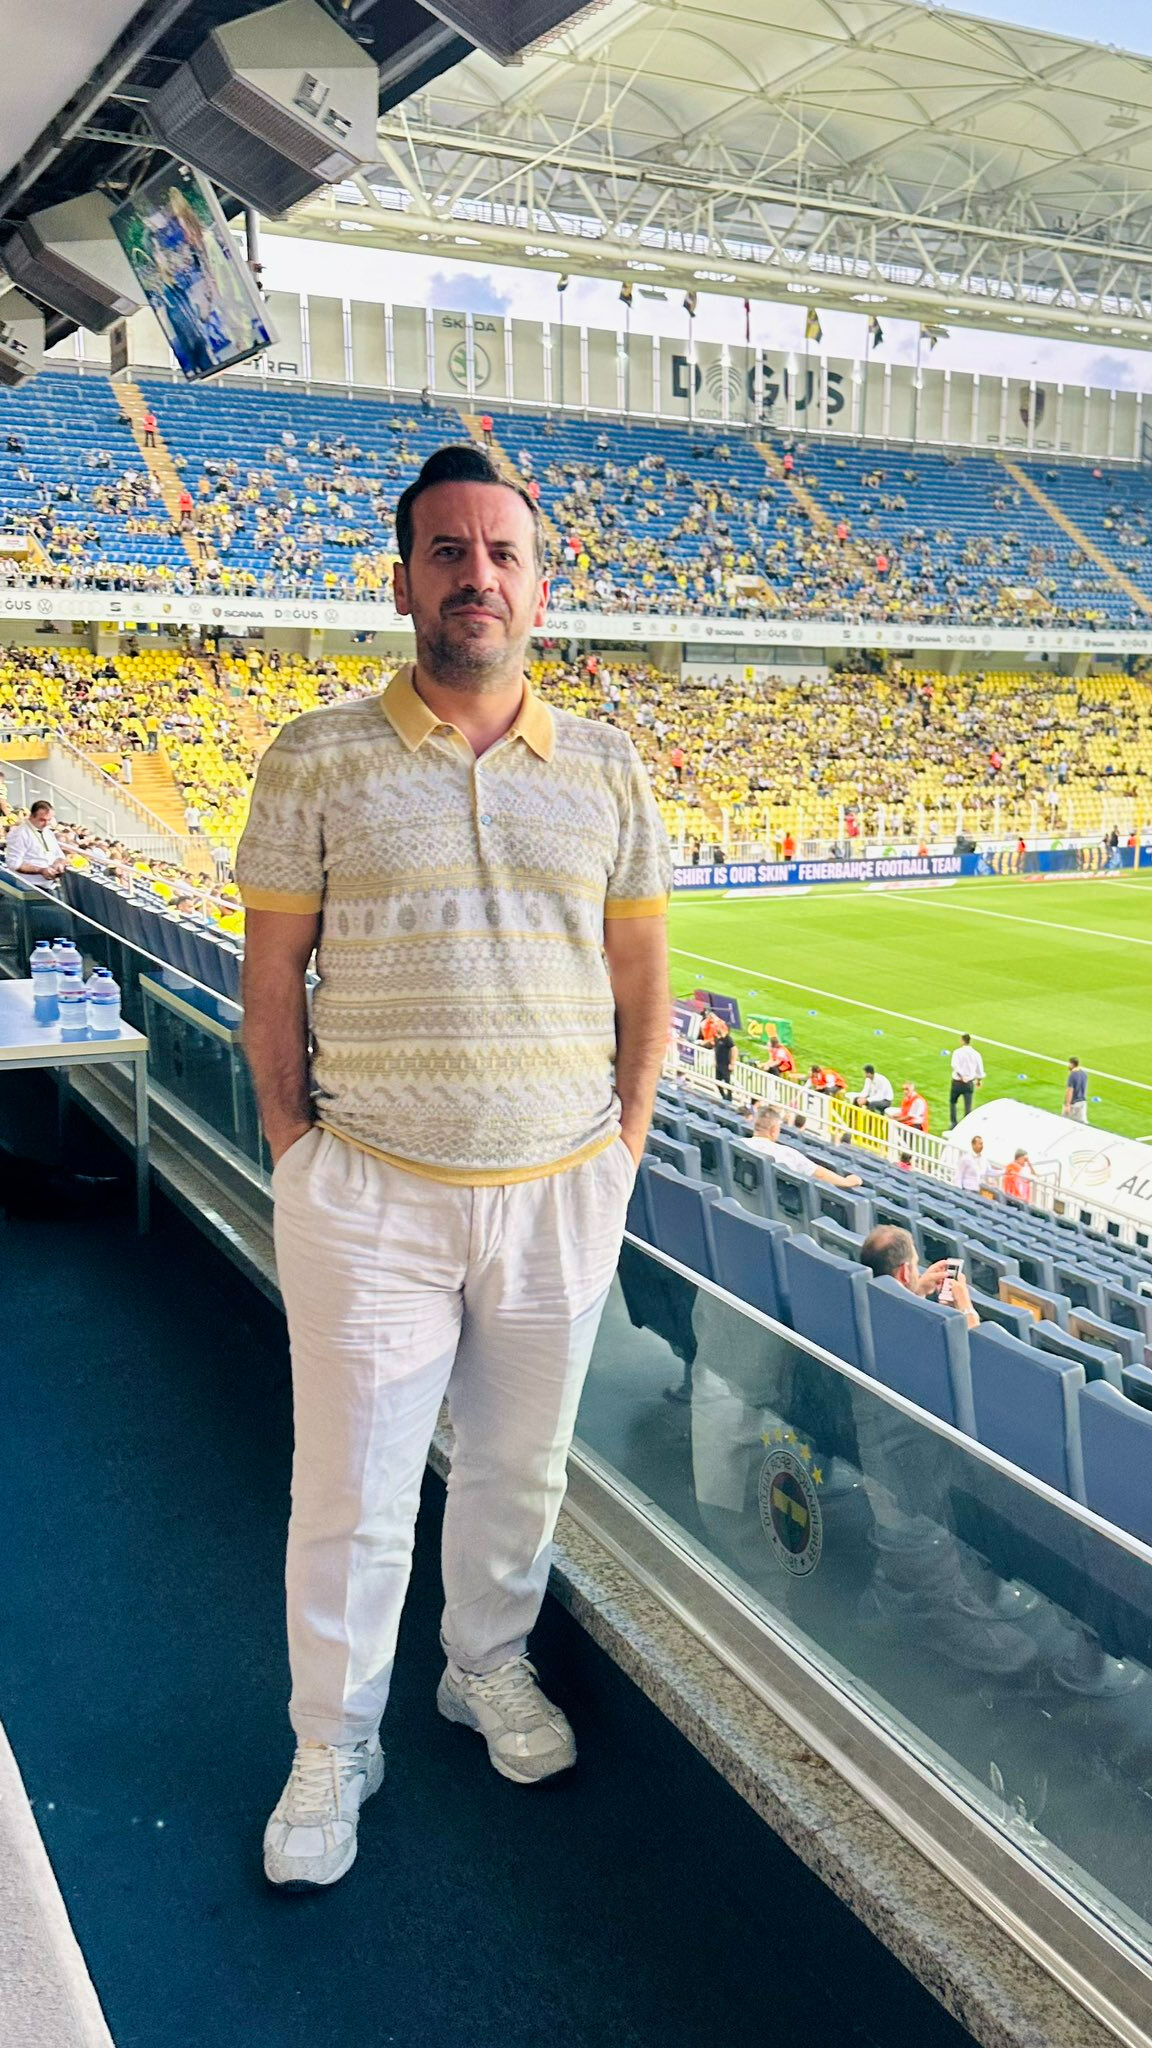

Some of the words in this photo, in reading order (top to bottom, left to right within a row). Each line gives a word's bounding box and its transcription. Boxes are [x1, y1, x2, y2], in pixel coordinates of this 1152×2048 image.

[442, 315, 496, 332] ŠKDA
[224, 609, 264, 619] SCANIA
[673, 867, 712, 886] SHIRT
[713, 866, 728, 885] IS
[729, 865, 757, 884] OUR
[798, 861, 874, 881] FENERBAHÇE
[875, 858, 930, 877] FOOTBALL
[931, 856, 962, 874] TEAM
